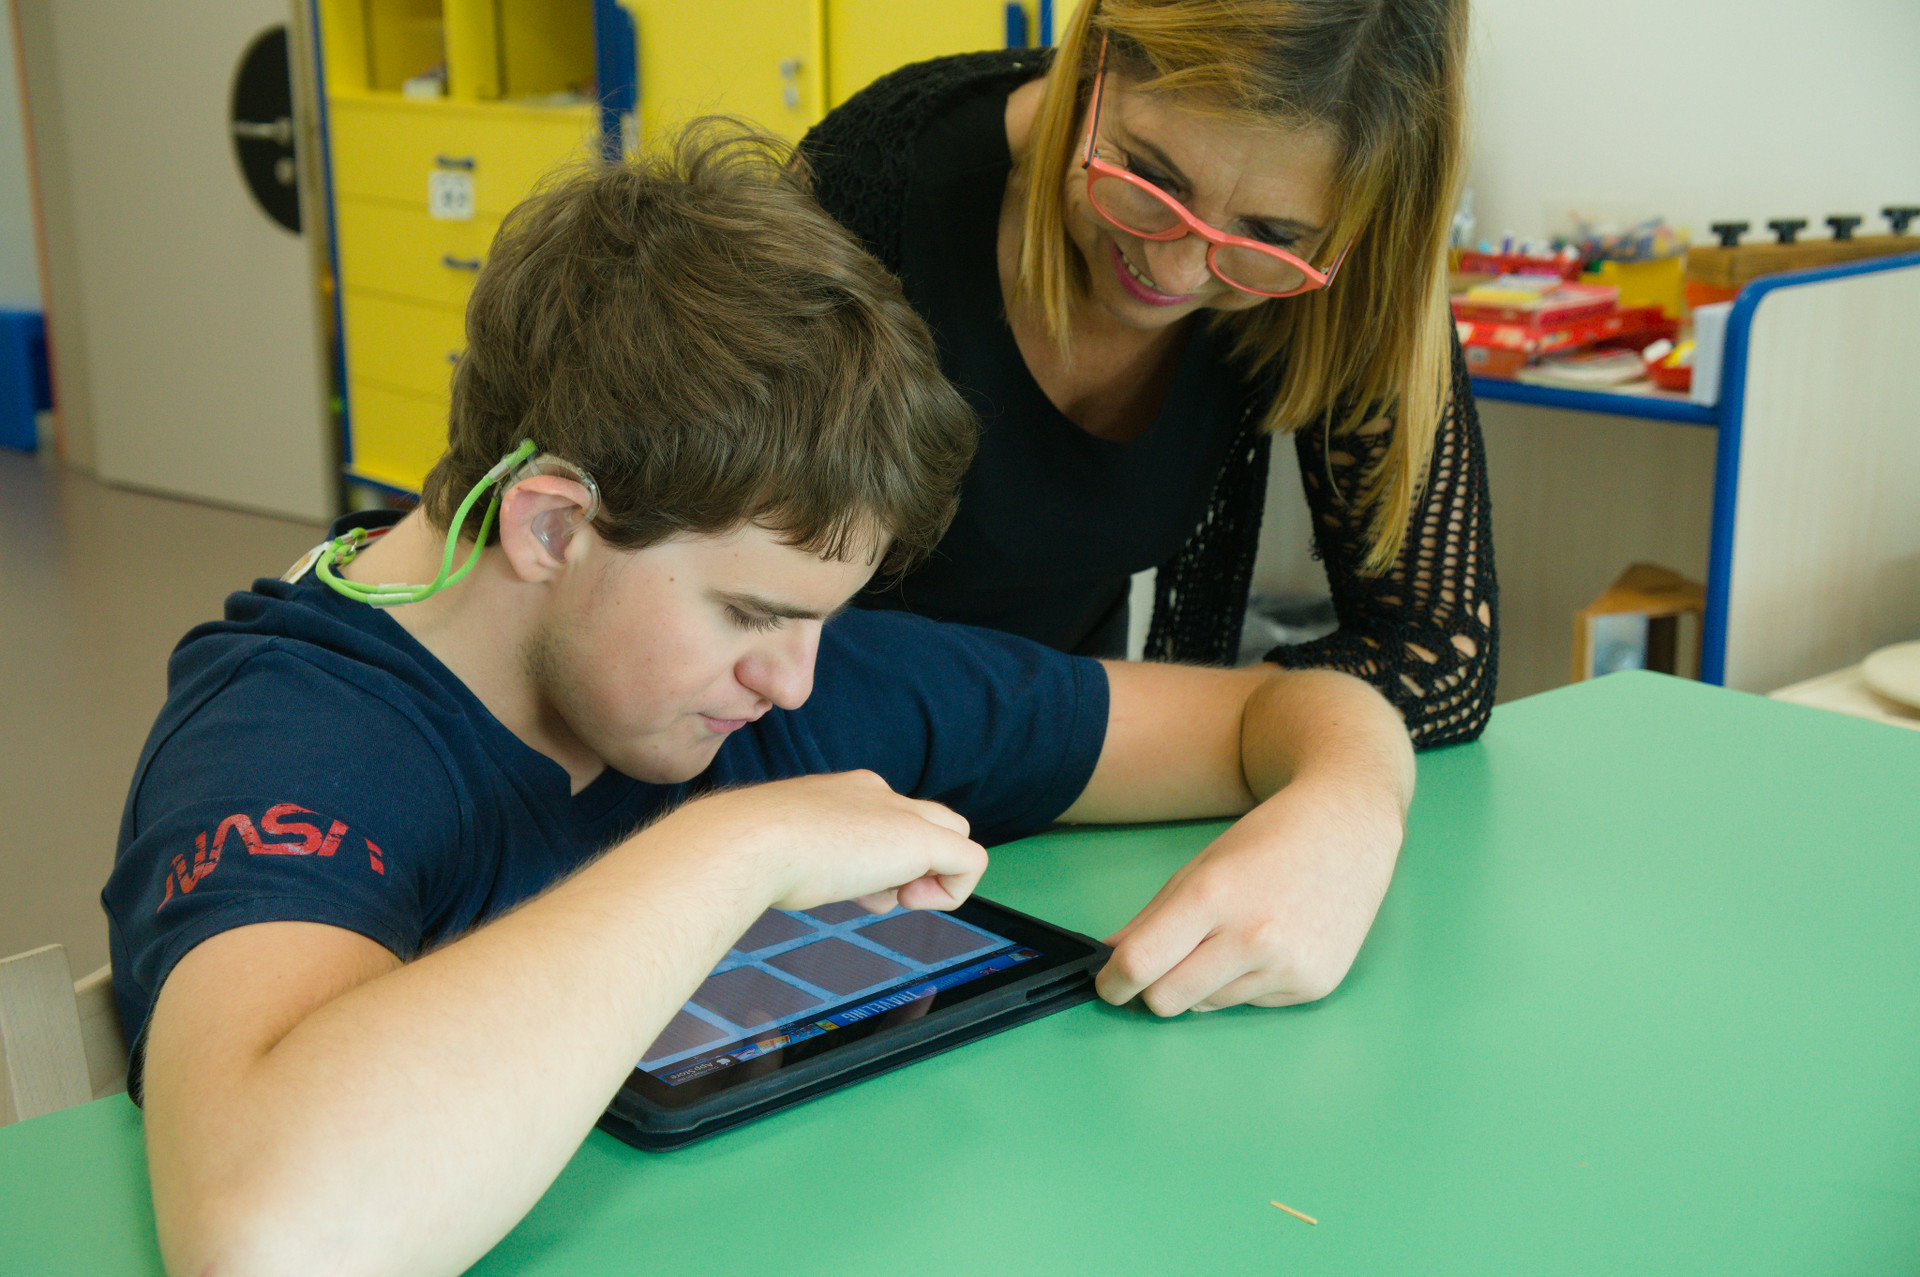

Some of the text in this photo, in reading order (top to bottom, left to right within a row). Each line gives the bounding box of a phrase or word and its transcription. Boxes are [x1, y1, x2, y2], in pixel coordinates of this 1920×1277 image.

[840, 990, 921, 1022] TRAVELING
[693, 1062, 714, 1072] App
[670, 1068, 693, 1080] Store
